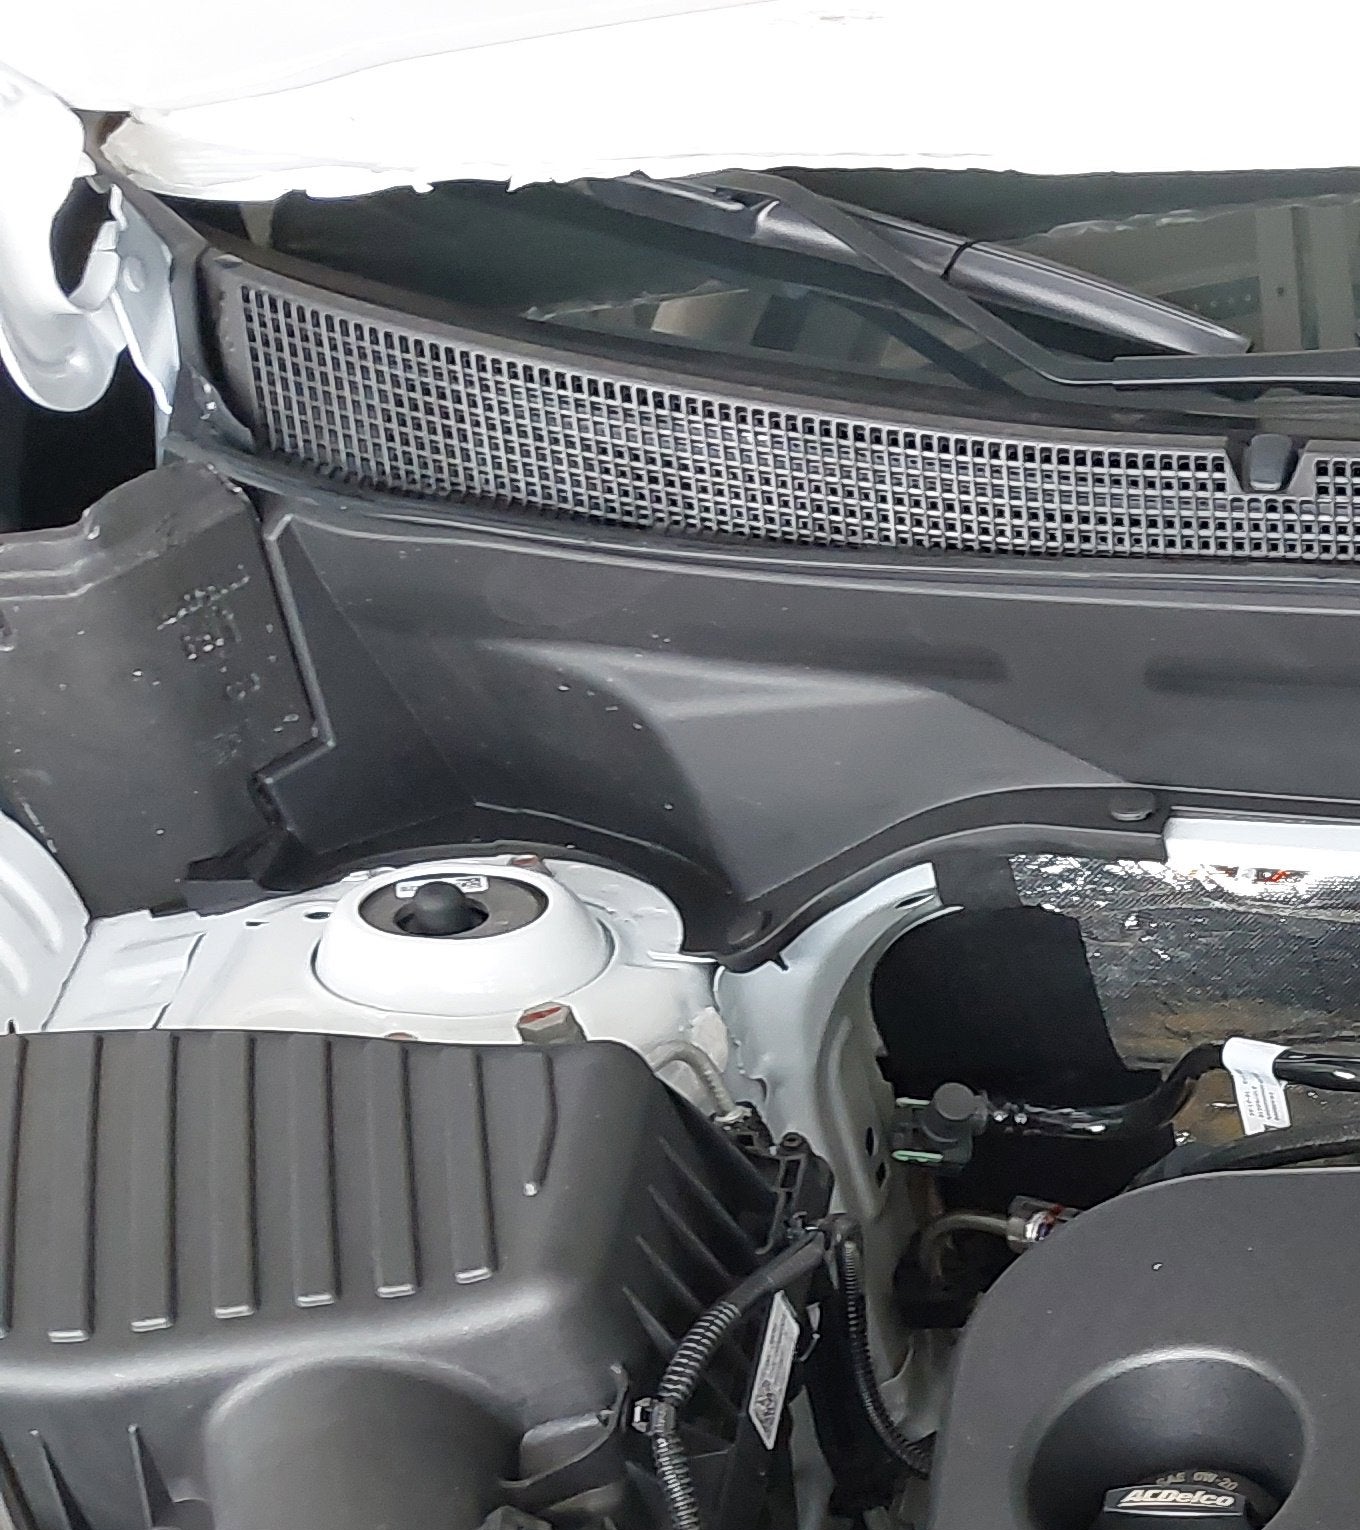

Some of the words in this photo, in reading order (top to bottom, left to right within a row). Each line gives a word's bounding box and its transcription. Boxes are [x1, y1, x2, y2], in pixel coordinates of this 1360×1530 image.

[1156, 1472, 1186, 1487] SAE
[1193, 1471, 1239, 1491] 0W-20
[1120, 1489, 1236, 1507] ACDelco
